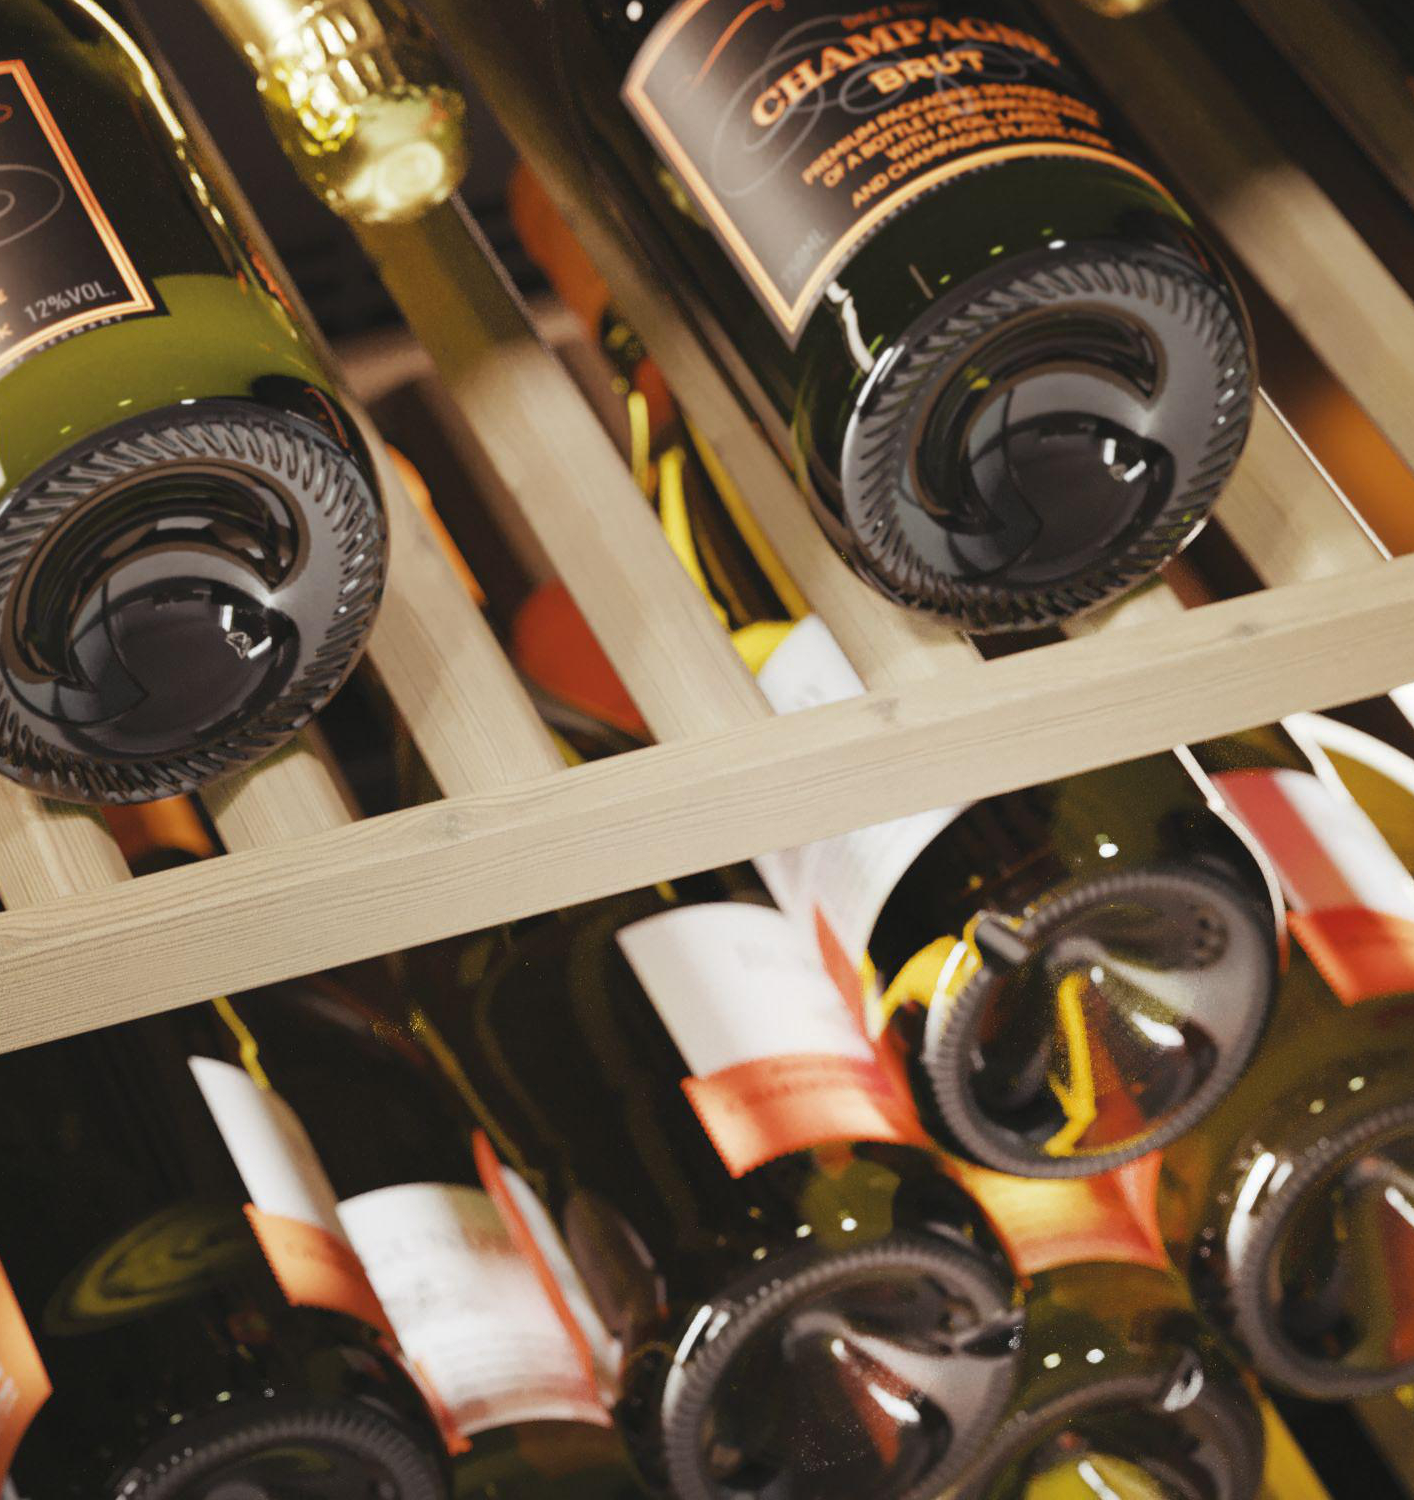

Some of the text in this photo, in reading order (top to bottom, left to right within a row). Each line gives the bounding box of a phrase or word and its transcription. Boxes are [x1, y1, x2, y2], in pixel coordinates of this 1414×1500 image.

[867, 50, 984, 94] BRUT
[801, 120, 878, 185] PREMIUM
[822, 161, 846, 188] OF
[846, 152, 863, 171] A
[859, 115, 927, 160] BOTTLE
[851, 172, 890, 209] AND
[887, 128, 1000, 181] CHAMPAGNE
[886, 129, 936, 160] WITH
[23, 280, 117, 323] 12%VOL.
